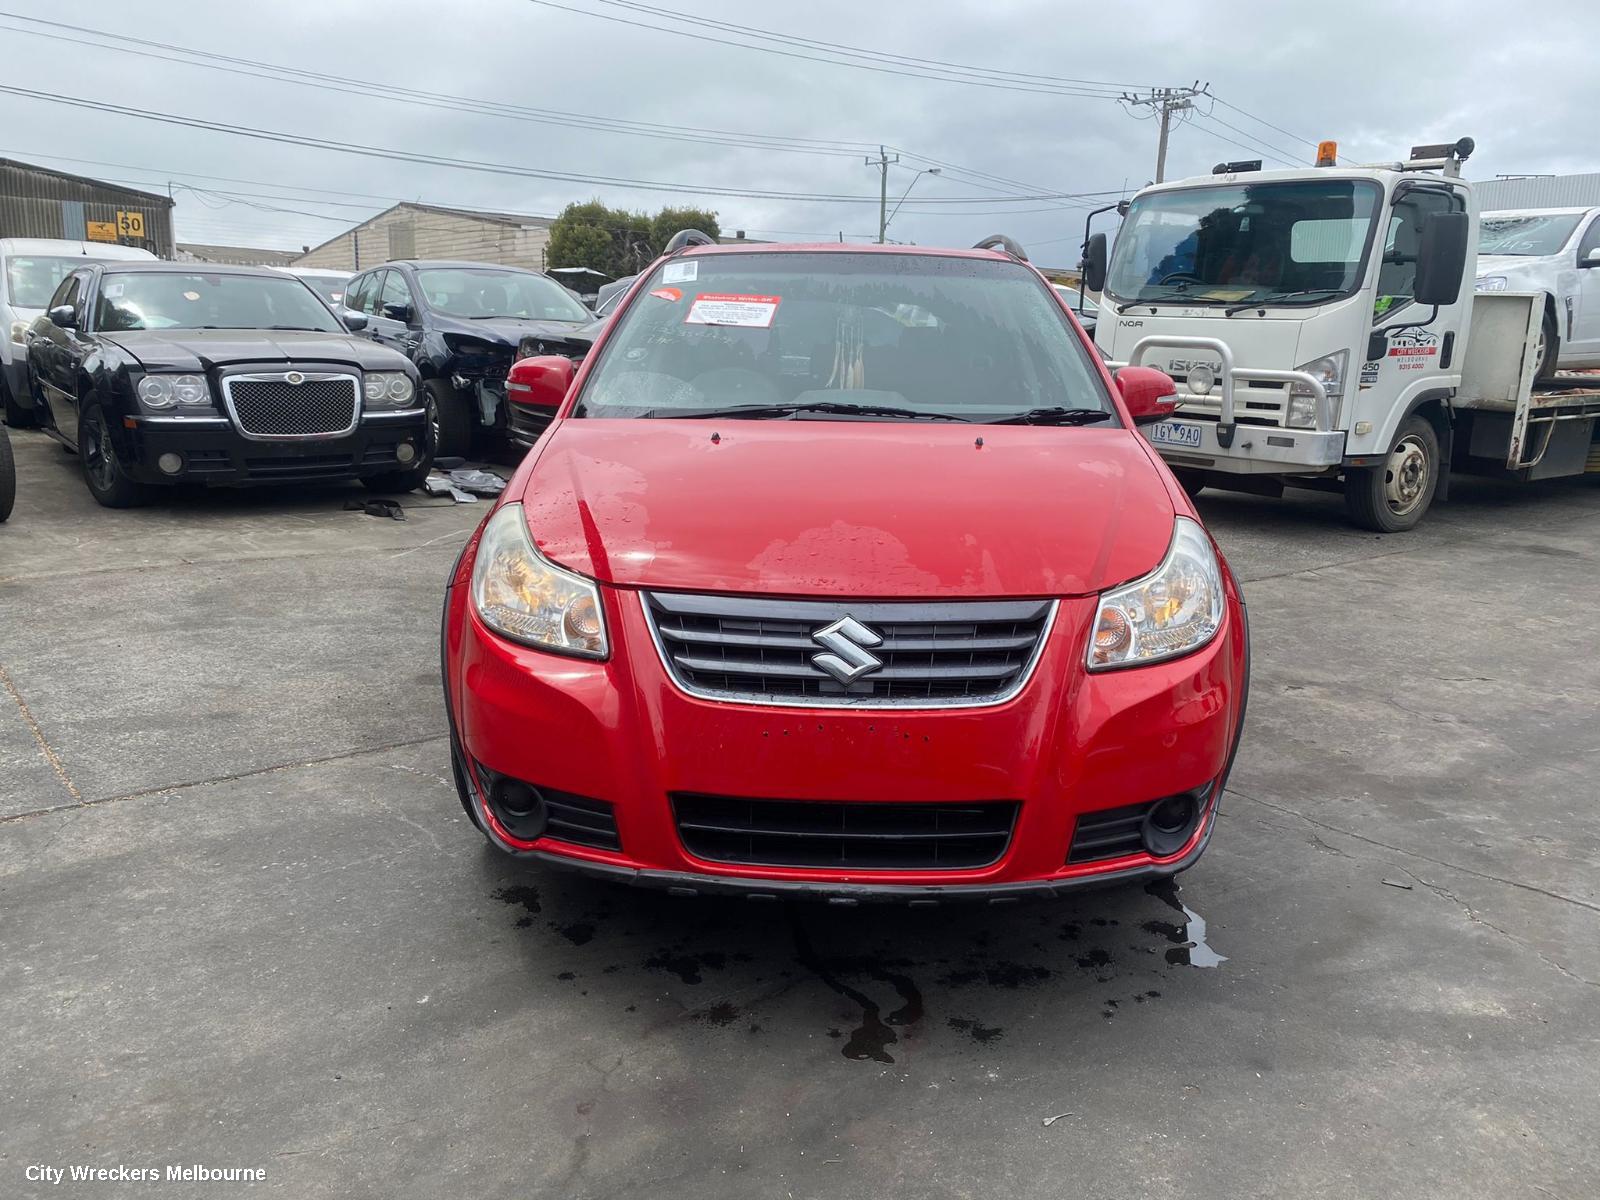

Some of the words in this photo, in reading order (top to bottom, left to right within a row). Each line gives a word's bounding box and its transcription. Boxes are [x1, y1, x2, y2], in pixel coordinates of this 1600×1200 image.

[121, 216, 141, 231] 50
[1119, 320, 1144, 328] NQR
[1361, 362, 1380, 371] 450
